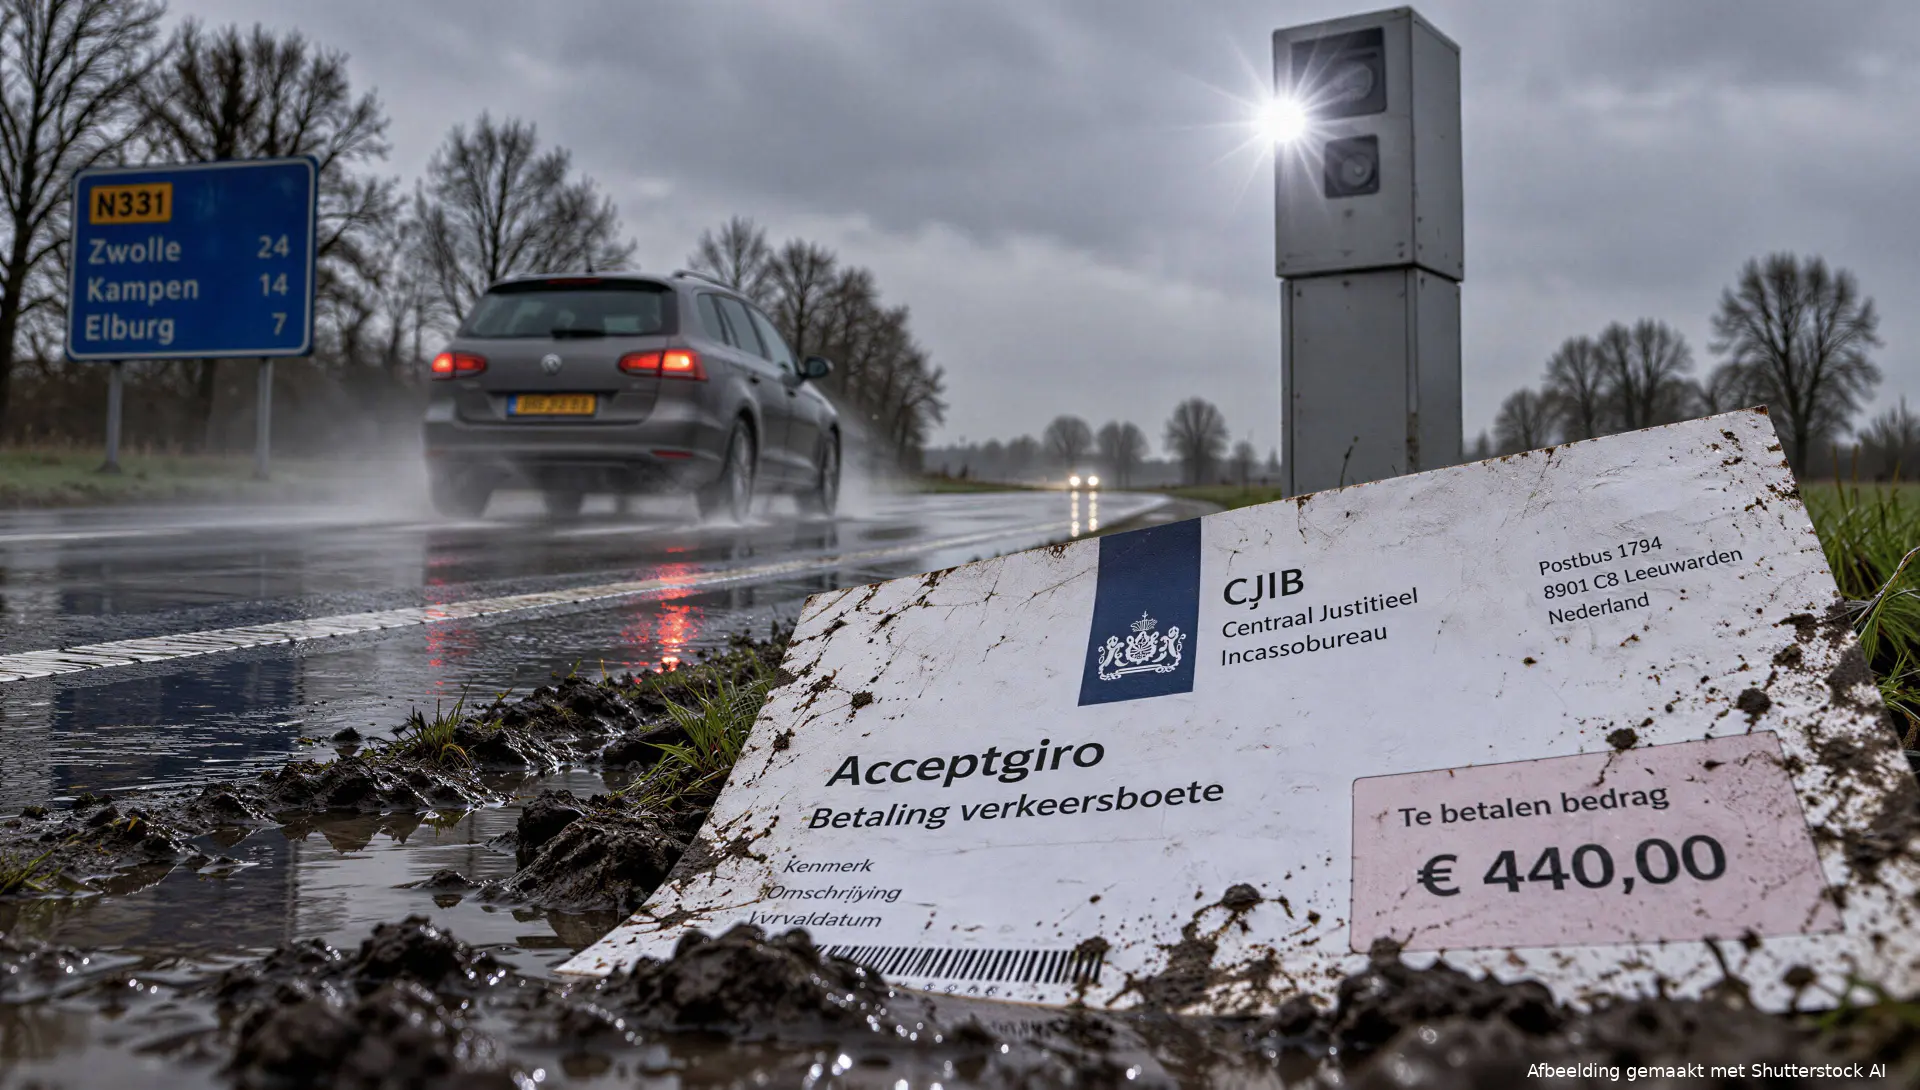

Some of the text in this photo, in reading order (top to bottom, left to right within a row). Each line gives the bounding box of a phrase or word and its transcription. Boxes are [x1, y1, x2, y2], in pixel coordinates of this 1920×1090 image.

[97, 191, 164, 217] N331
[88, 234, 290, 265] Zwolle 24
[87, 273, 289, 306] Kampen 14
[84, 312, 288, 346] Elburg 7
[1538, 536, 1663, 576] Postbus 1794
[1544, 548, 1743, 600] 8901 C8 Leeuwarden
[1223, 568, 1304, 610] CJIB
[1548, 592, 1650, 625] Nederland
[1222, 587, 1418, 638] Centraal Justitieel
[1221, 626, 1388, 666] Incassobureau
[826, 738, 1104, 788] Acceptgiro
[808, 781, 1225, 830] Betaling verkeersboete
[1398, 786, 1670, 827] Te betalen bedrag
[783, 858, 875, 873] Kenmerk
[1417, 834, 1727, 897] € 440,00
